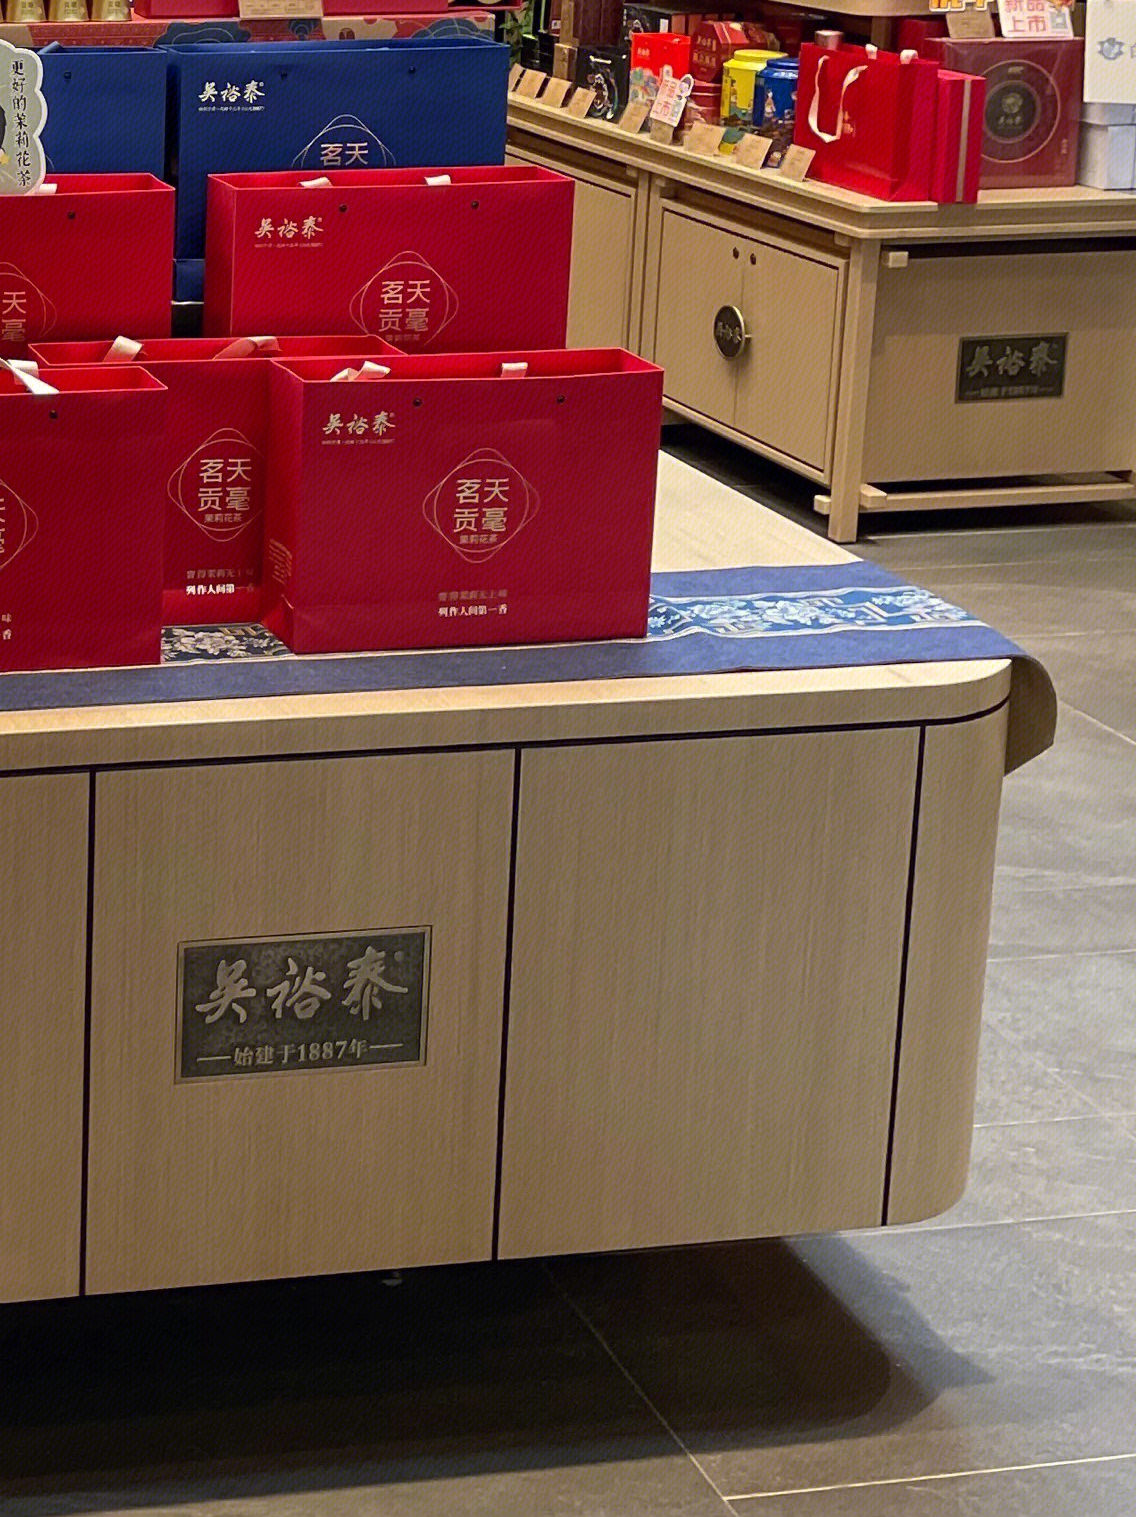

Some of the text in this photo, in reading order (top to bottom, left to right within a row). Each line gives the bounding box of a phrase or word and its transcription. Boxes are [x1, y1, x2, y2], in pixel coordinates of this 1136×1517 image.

[1007, 16, 1047, 33] 上市
[198, 80, 266, 104] 吴裕泰
[11, 59, 32, 187] 更好的茉莉花茶
[319, 142, 370, 167] 茗天
[254, 216, 324, 240] 吴裕泰
[380, 279, 432, 305] 茗天
[378, 307, 431, 333] 贡毫
[966, 340, 1059, 378] 吴裕泰
[322, 411, 396, 437] 吴裕泰
[199, 458, 253, 483] 茗天
[198, 486, 252, 512] 贡毫
[455, 478, 510, 504] 茗天
[453, 506, 508, 533] 贡毫
[195, 945, 409, 1024] 吴裕泰
[233, 1038, 368, 1067] 始建于1887年
